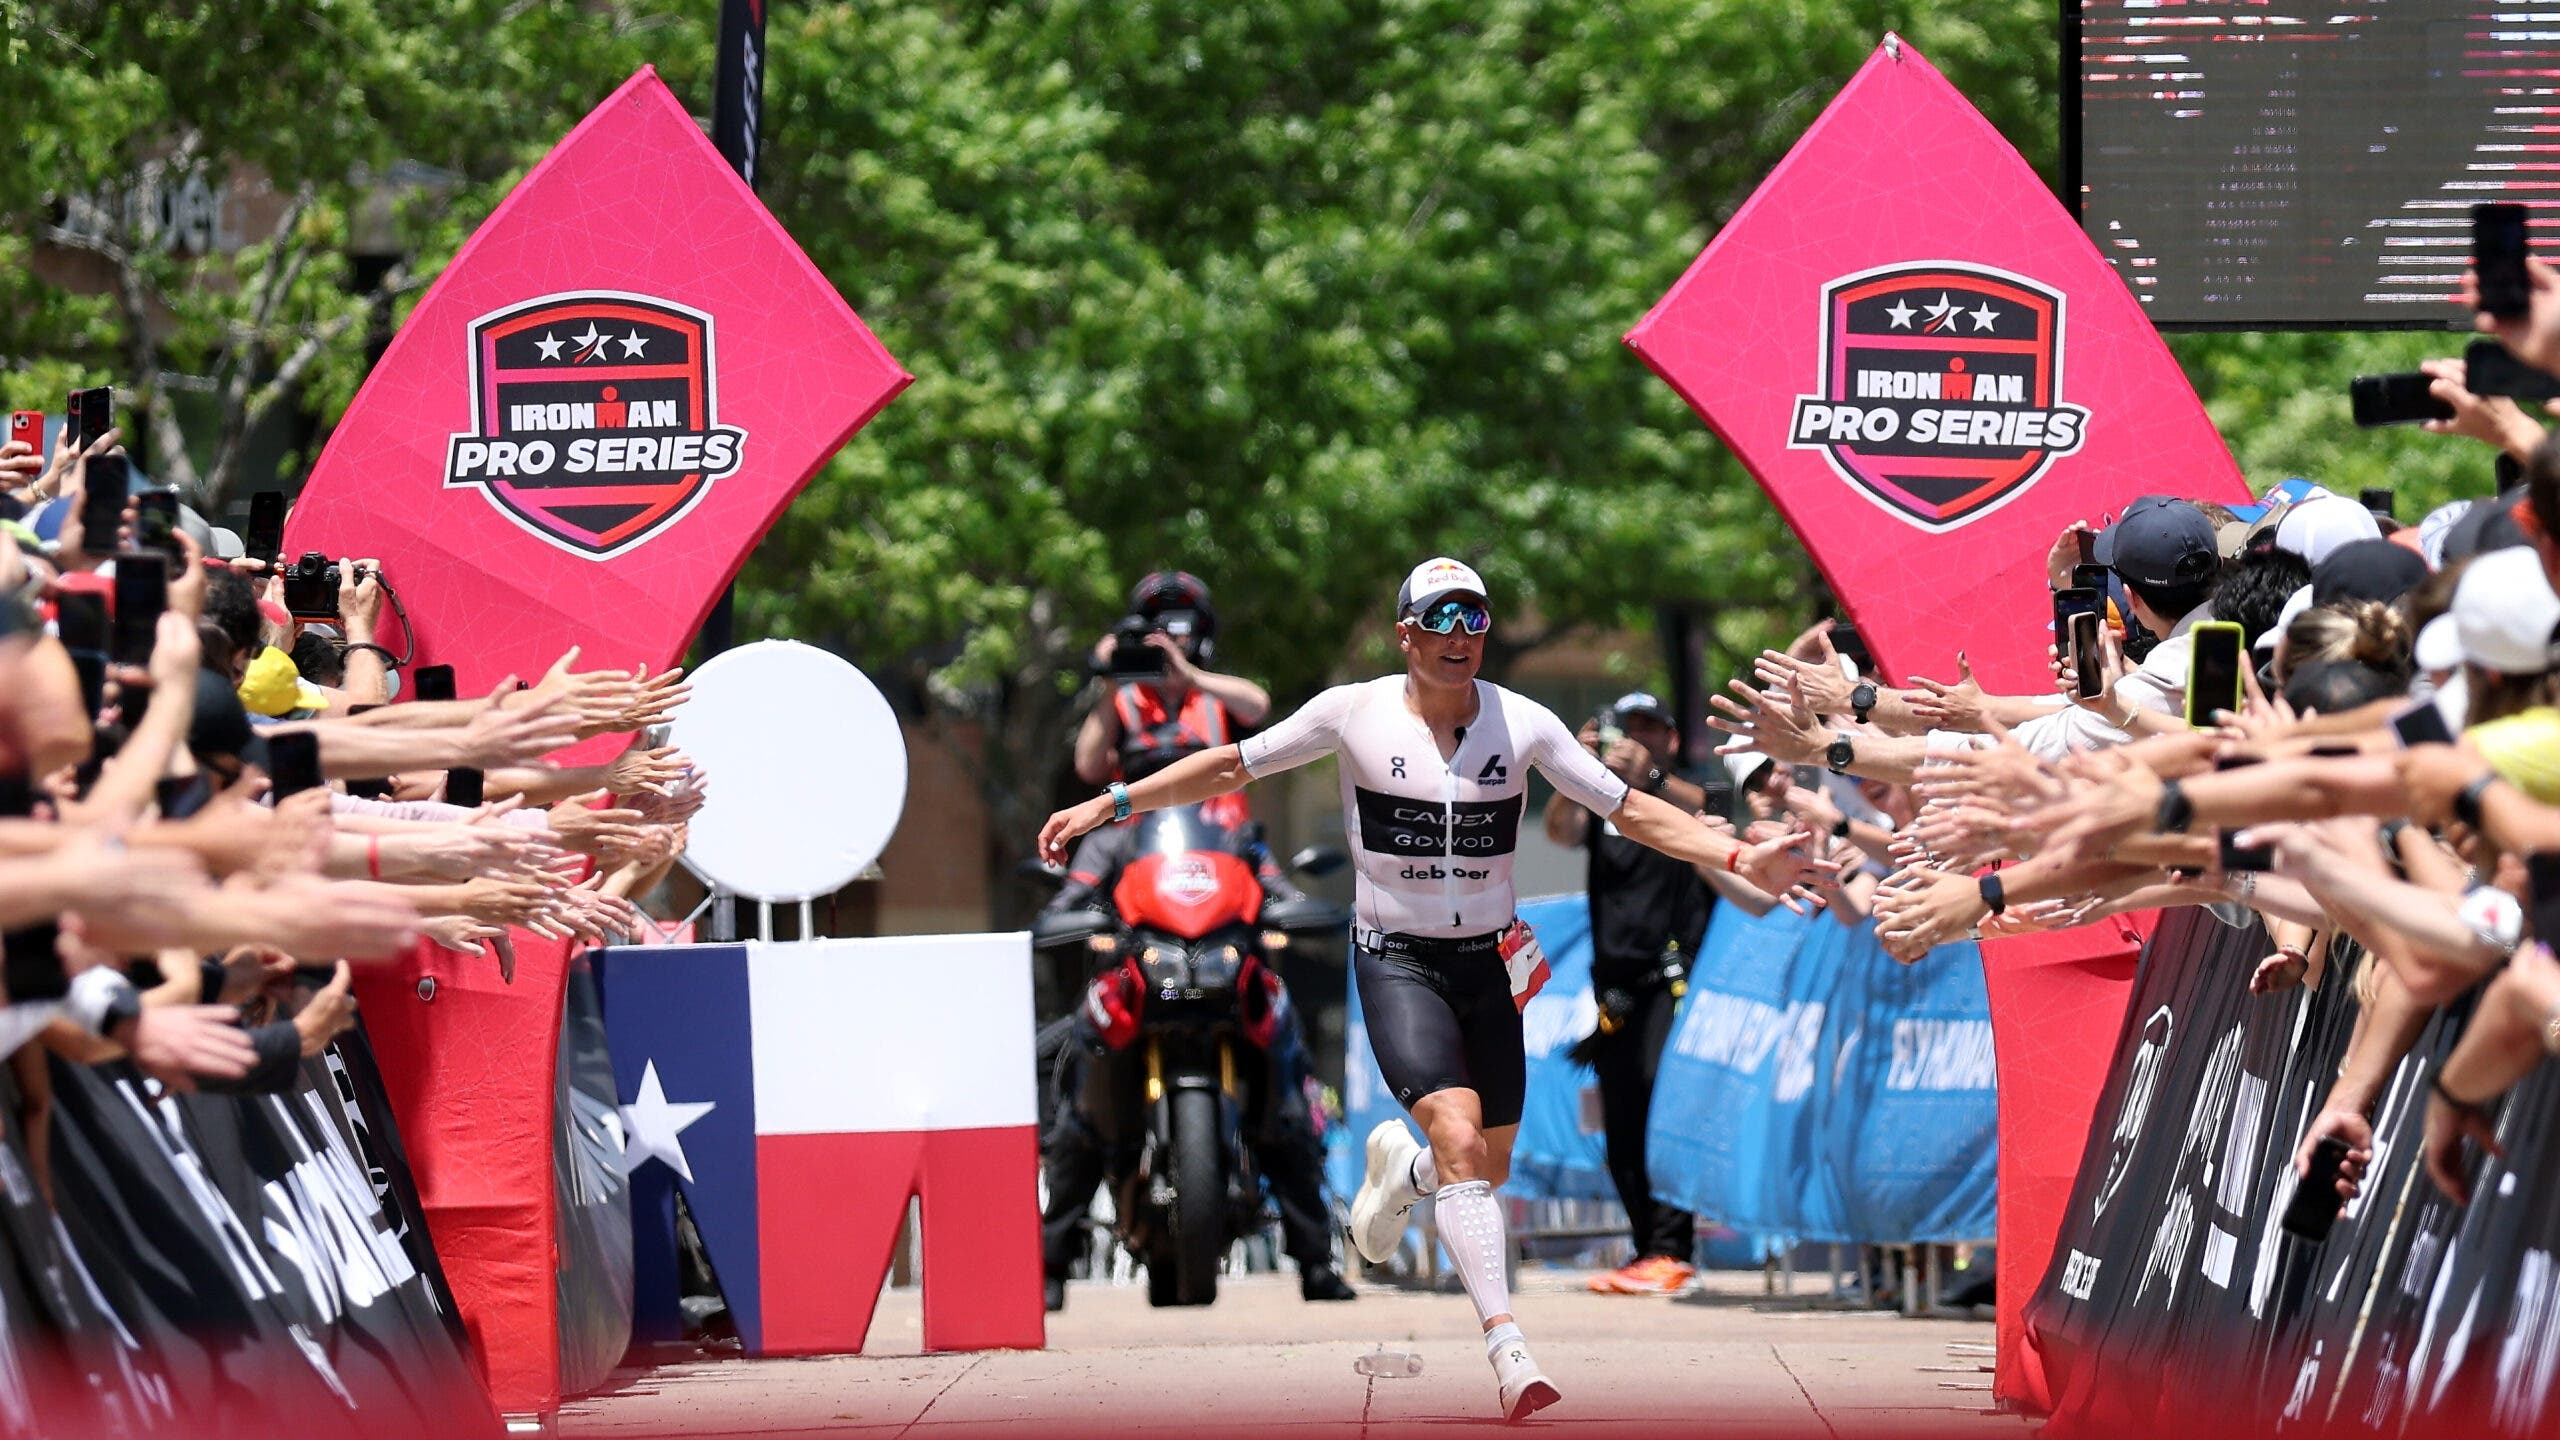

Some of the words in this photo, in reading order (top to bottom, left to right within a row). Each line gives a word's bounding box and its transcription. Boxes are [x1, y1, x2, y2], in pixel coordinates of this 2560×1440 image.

[1857, 357, 2024, 403] IRONMAN
[511, 386, 677, 431] IRONMAN
[1799, 405, 1900, 442] PRO
[1906, 408, 2078, 448] SERIES
[455, 440, 556, 477] PRO
[563, 434, 735, 473] SERIES
[1428, 572, 1448, 585] Red
[1450, 573, 1471, 583] Bull
[1394, 807, 1497, 827] CADEX
[1394, 834, 1494, 848] GOWOD
[1400, 864, 1490, 880] deboer
